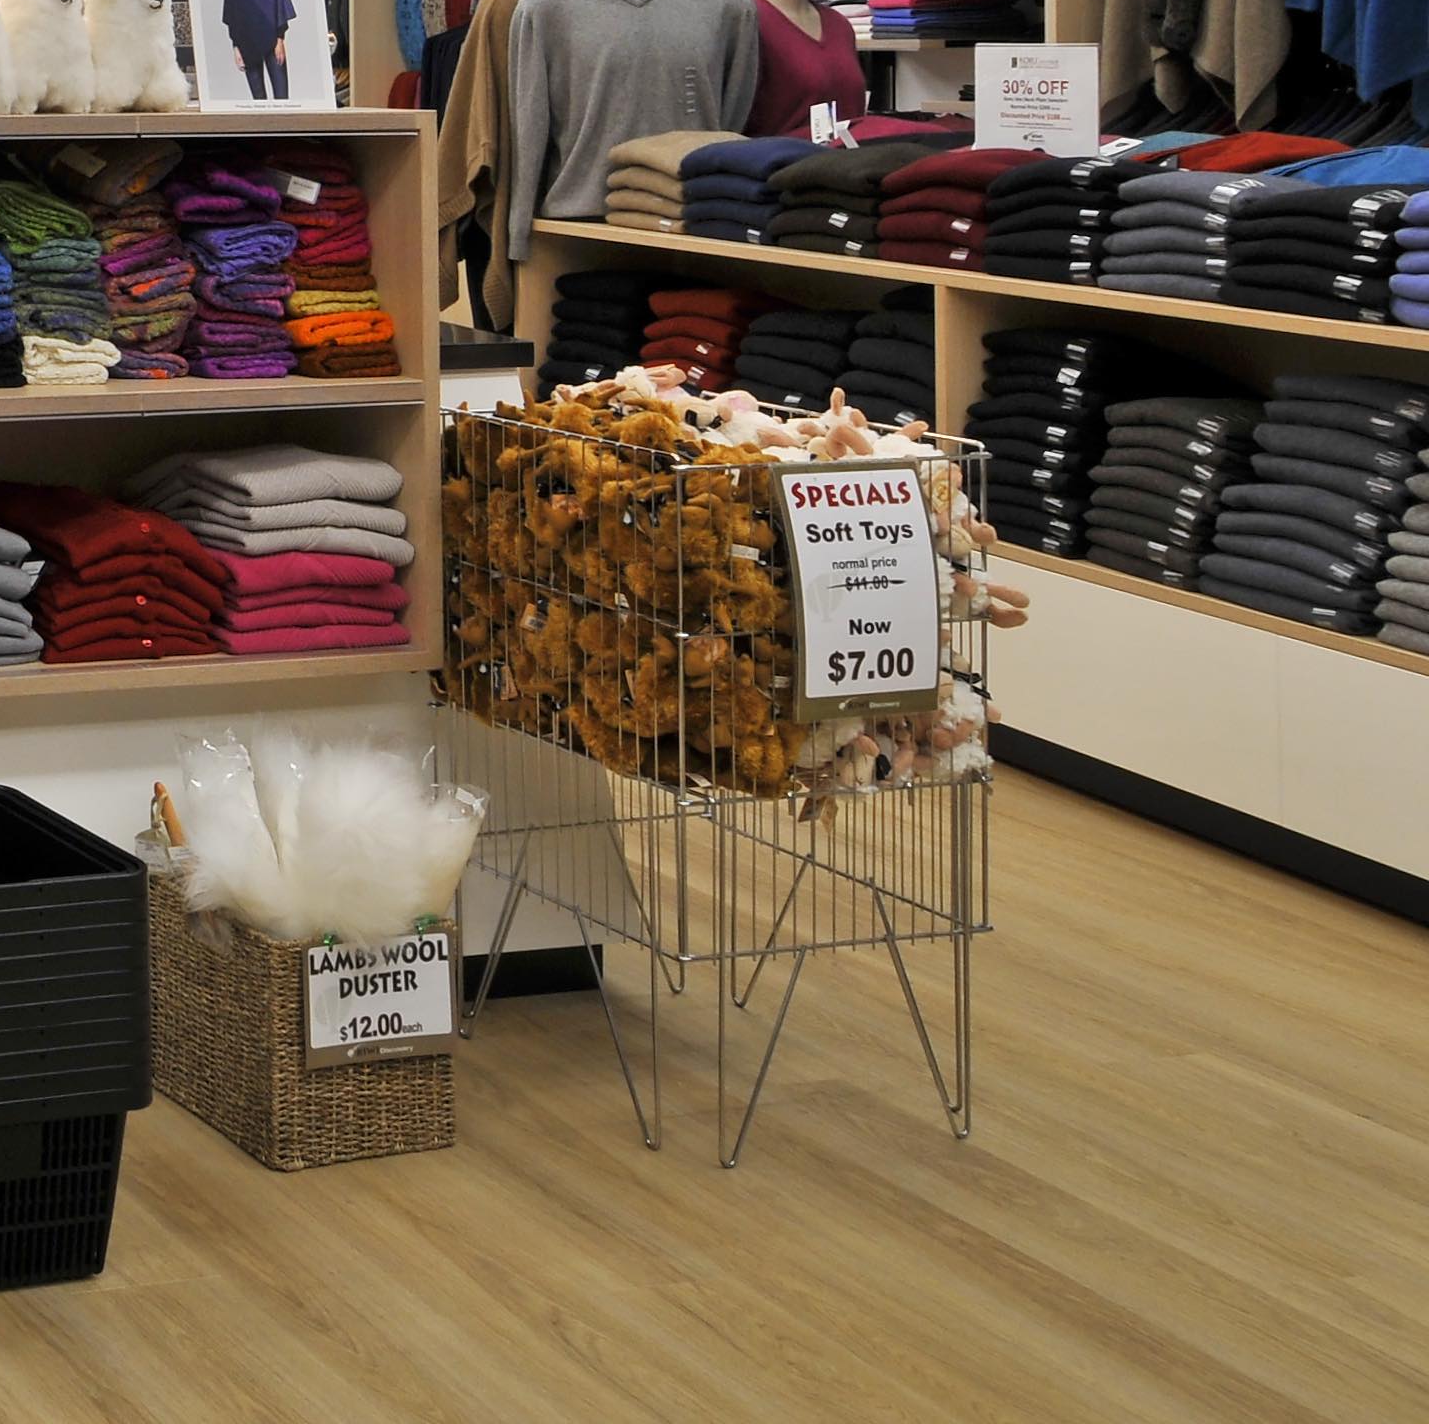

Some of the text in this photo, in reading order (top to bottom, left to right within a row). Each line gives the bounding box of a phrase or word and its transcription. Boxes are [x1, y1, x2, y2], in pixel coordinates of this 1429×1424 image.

[1003, 79, 1069, 95] 30% OFF
[791, 481, 911, 509] SPECIALS
[806, 521, 913, 544] Soft Toys
[832, 557, 897, 570] normal price
[849, 619, 891, 635] Now
[828, 647, 914, 686] $7.00
[310, 940, 448, 975] LAMBS WOOL
[340, 970, 418, 999] DUSTER
